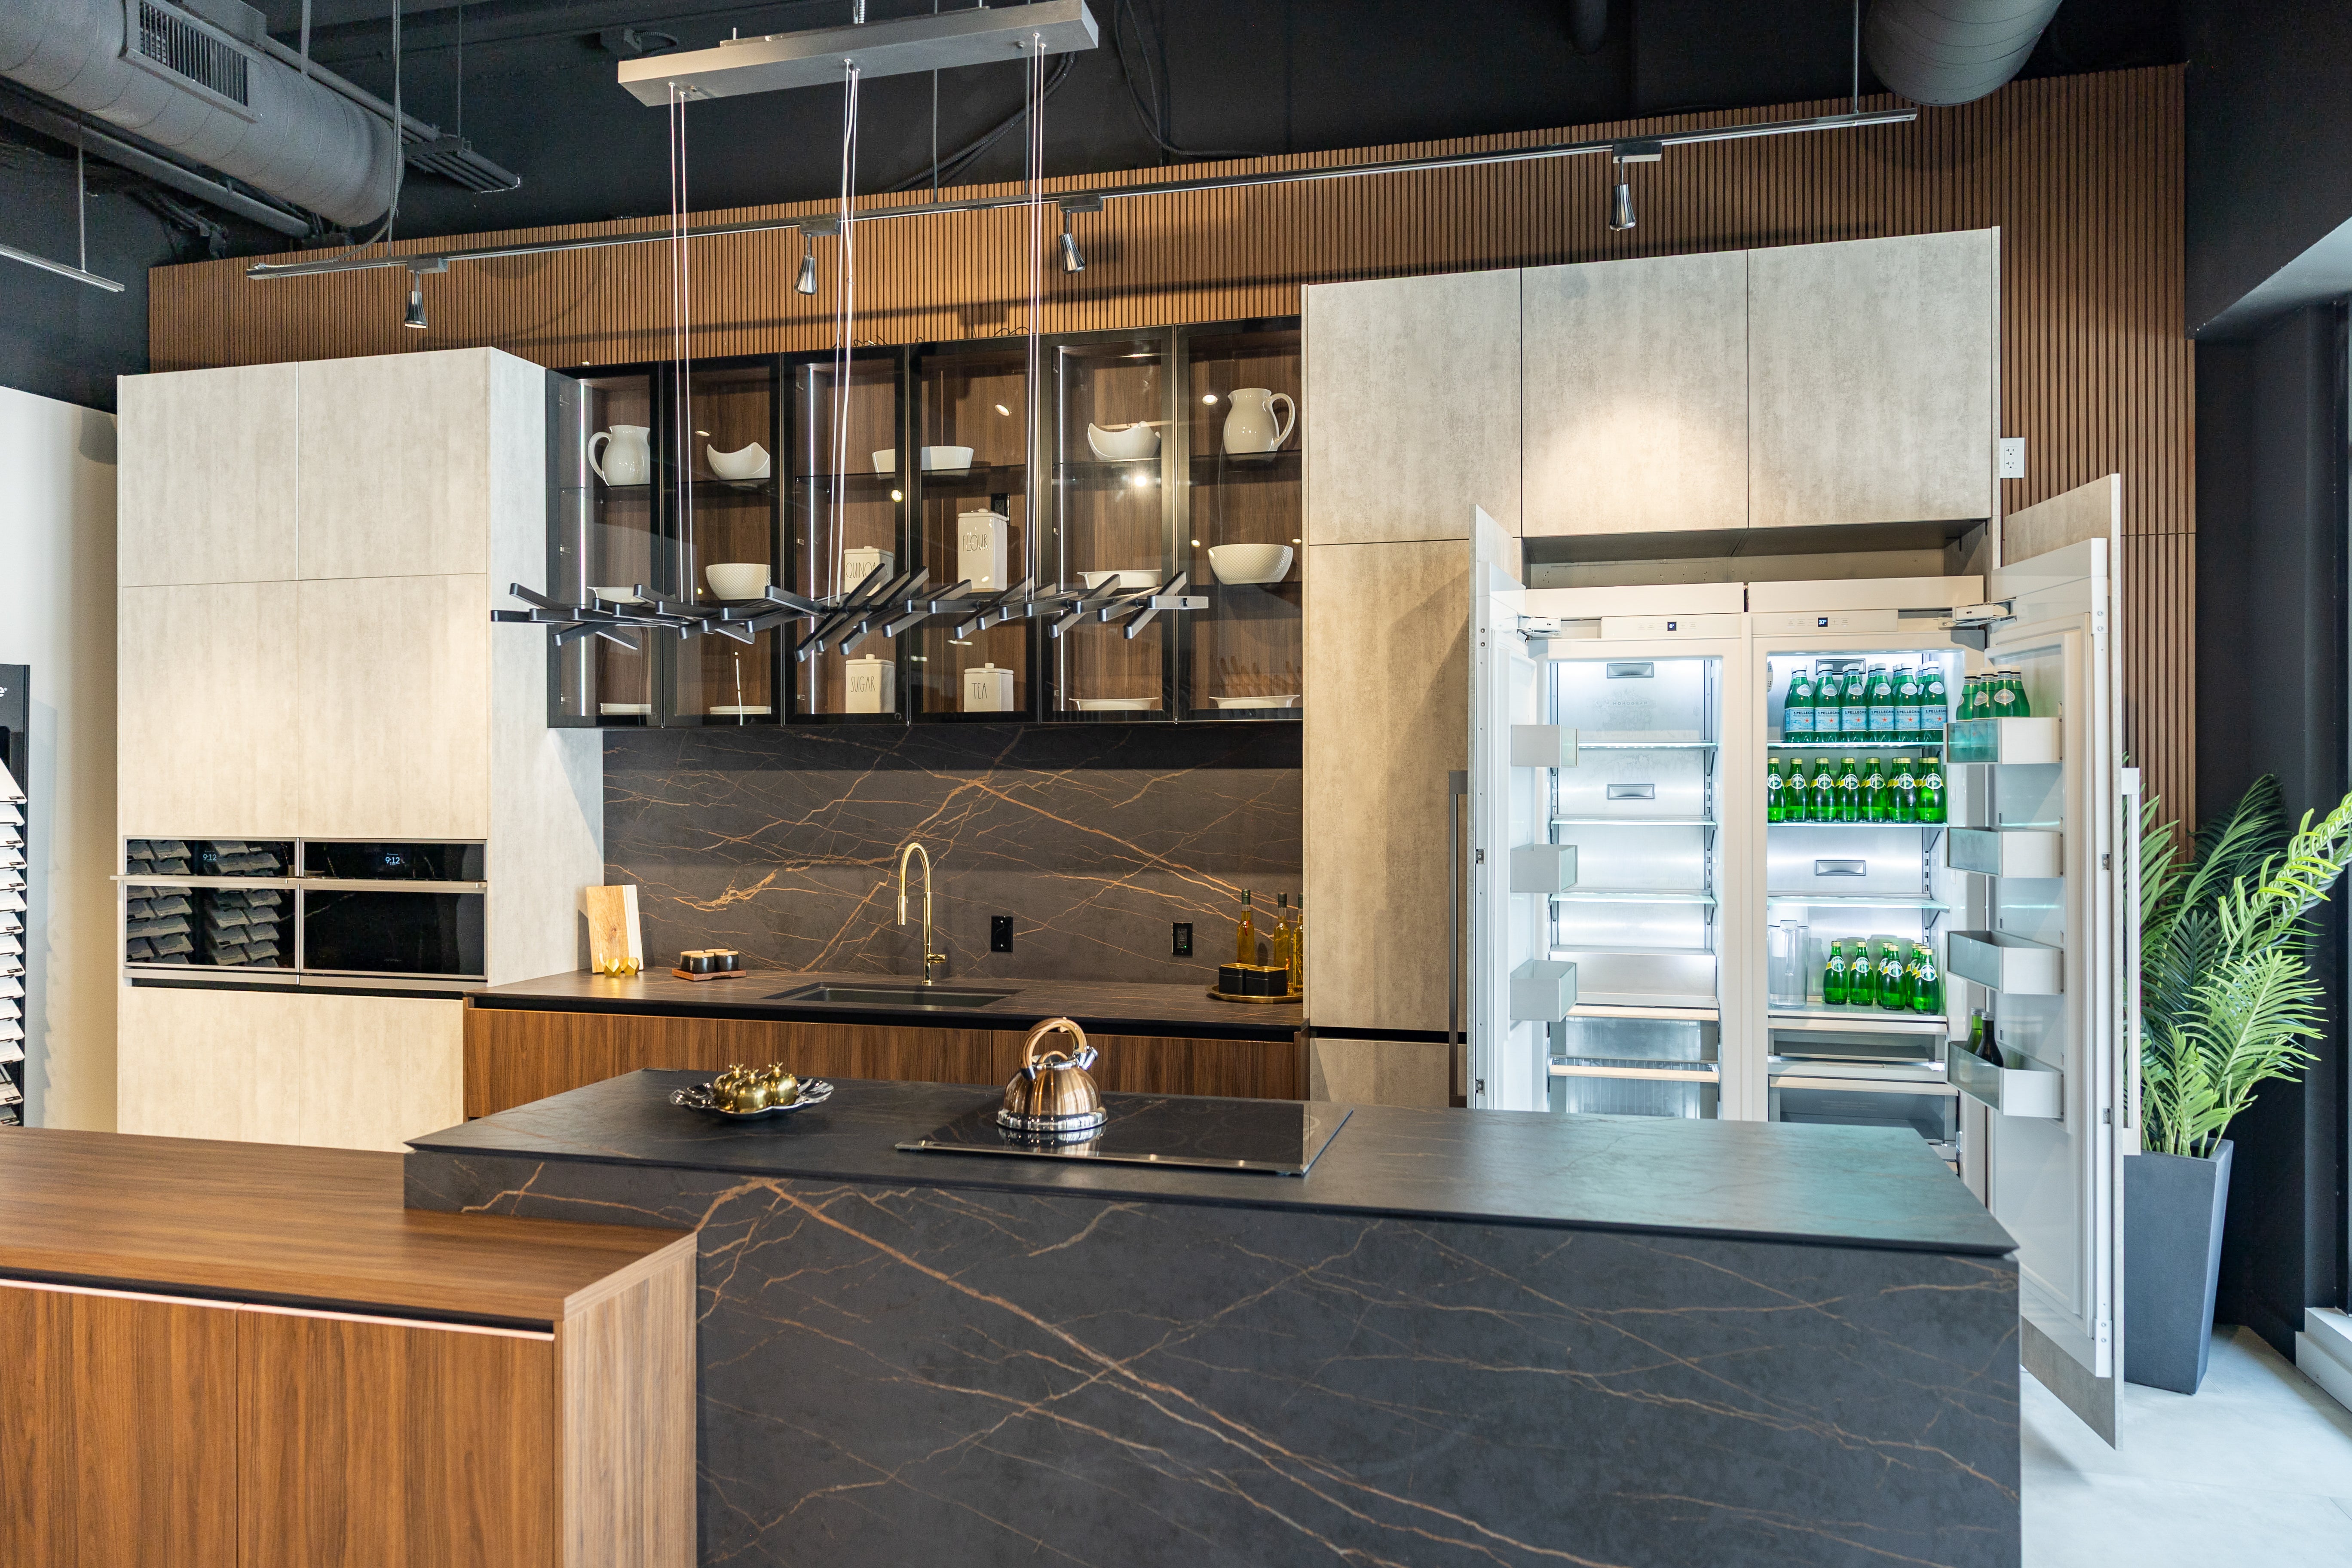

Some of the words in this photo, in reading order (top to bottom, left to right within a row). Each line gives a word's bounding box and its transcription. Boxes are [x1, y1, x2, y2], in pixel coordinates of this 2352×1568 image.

[963, 534, 989, 551] FLOUR
[850, 676, 876, 692] SUGAR
[971, 683, 987, 699] TEA
